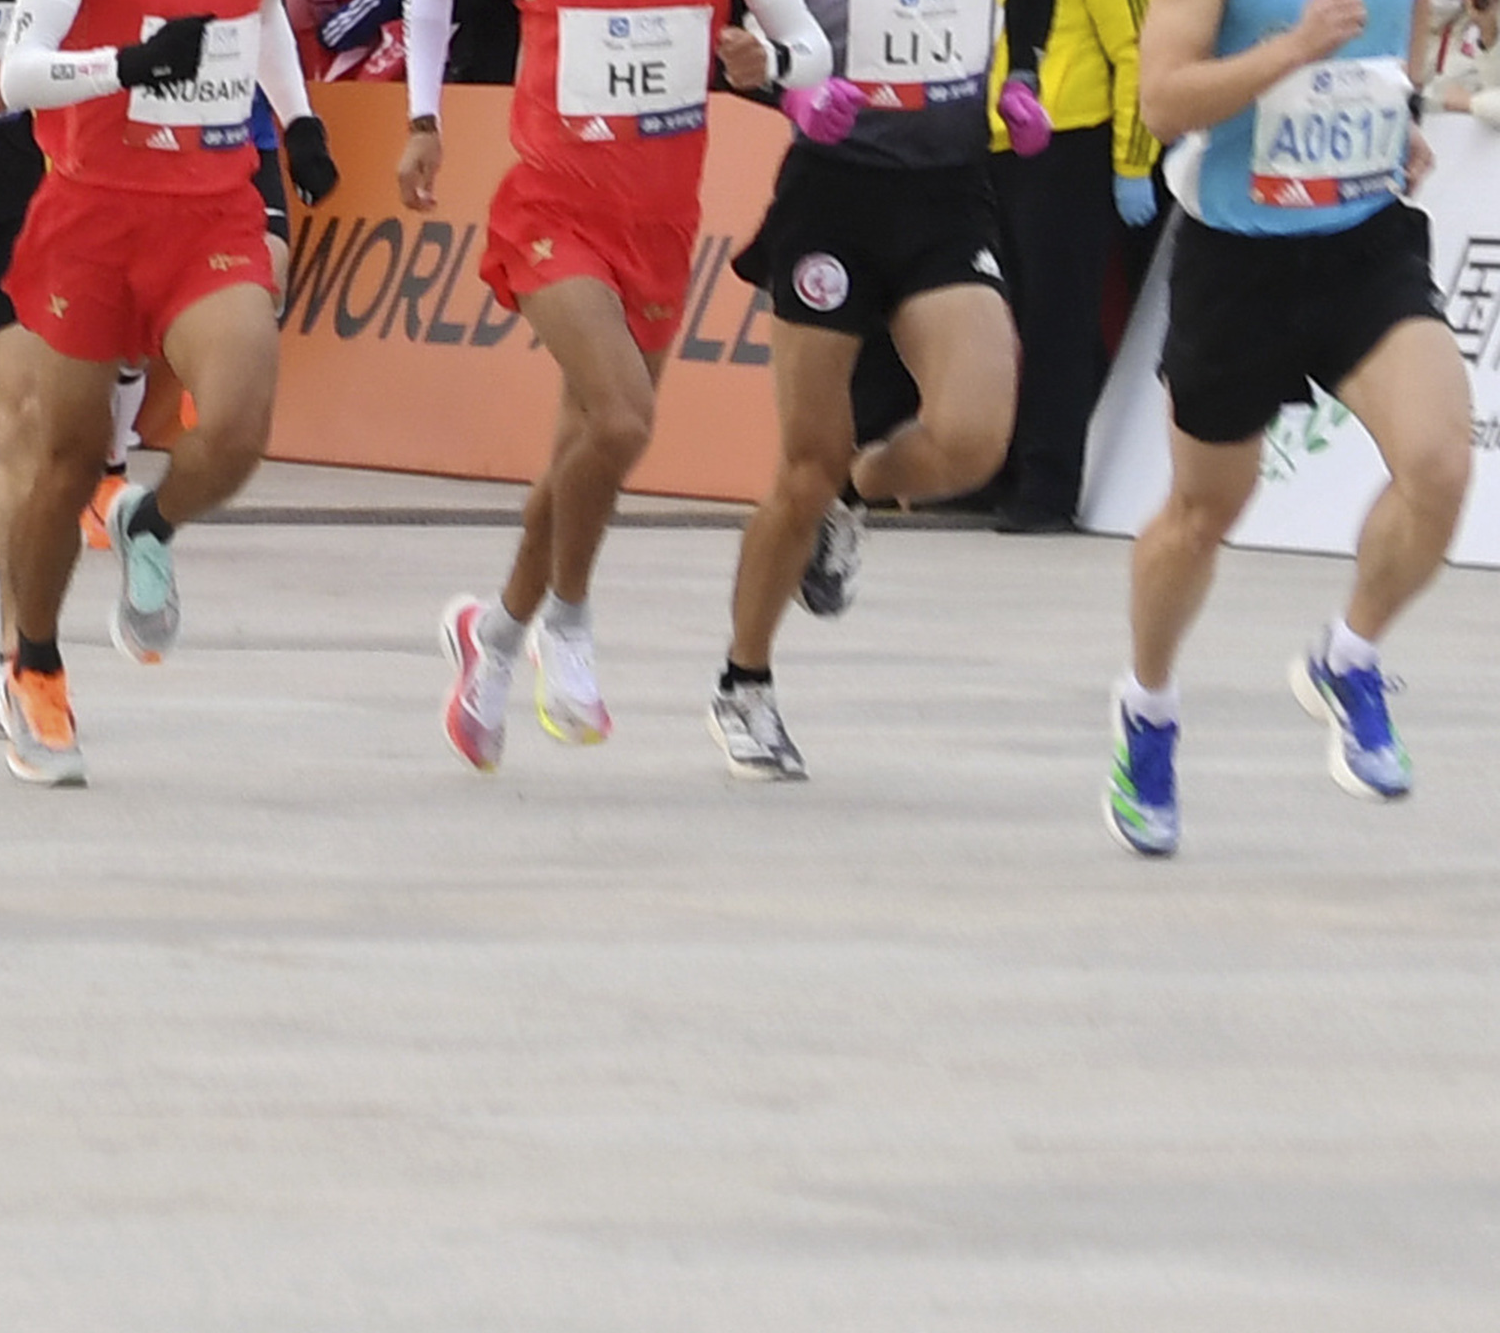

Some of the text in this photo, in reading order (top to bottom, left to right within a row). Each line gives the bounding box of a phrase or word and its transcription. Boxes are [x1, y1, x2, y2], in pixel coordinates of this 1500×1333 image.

[884, 31, 918, 65] LI
[607, 60, 667, 97] HE
[1268, 108, 1396, 165] A0617
